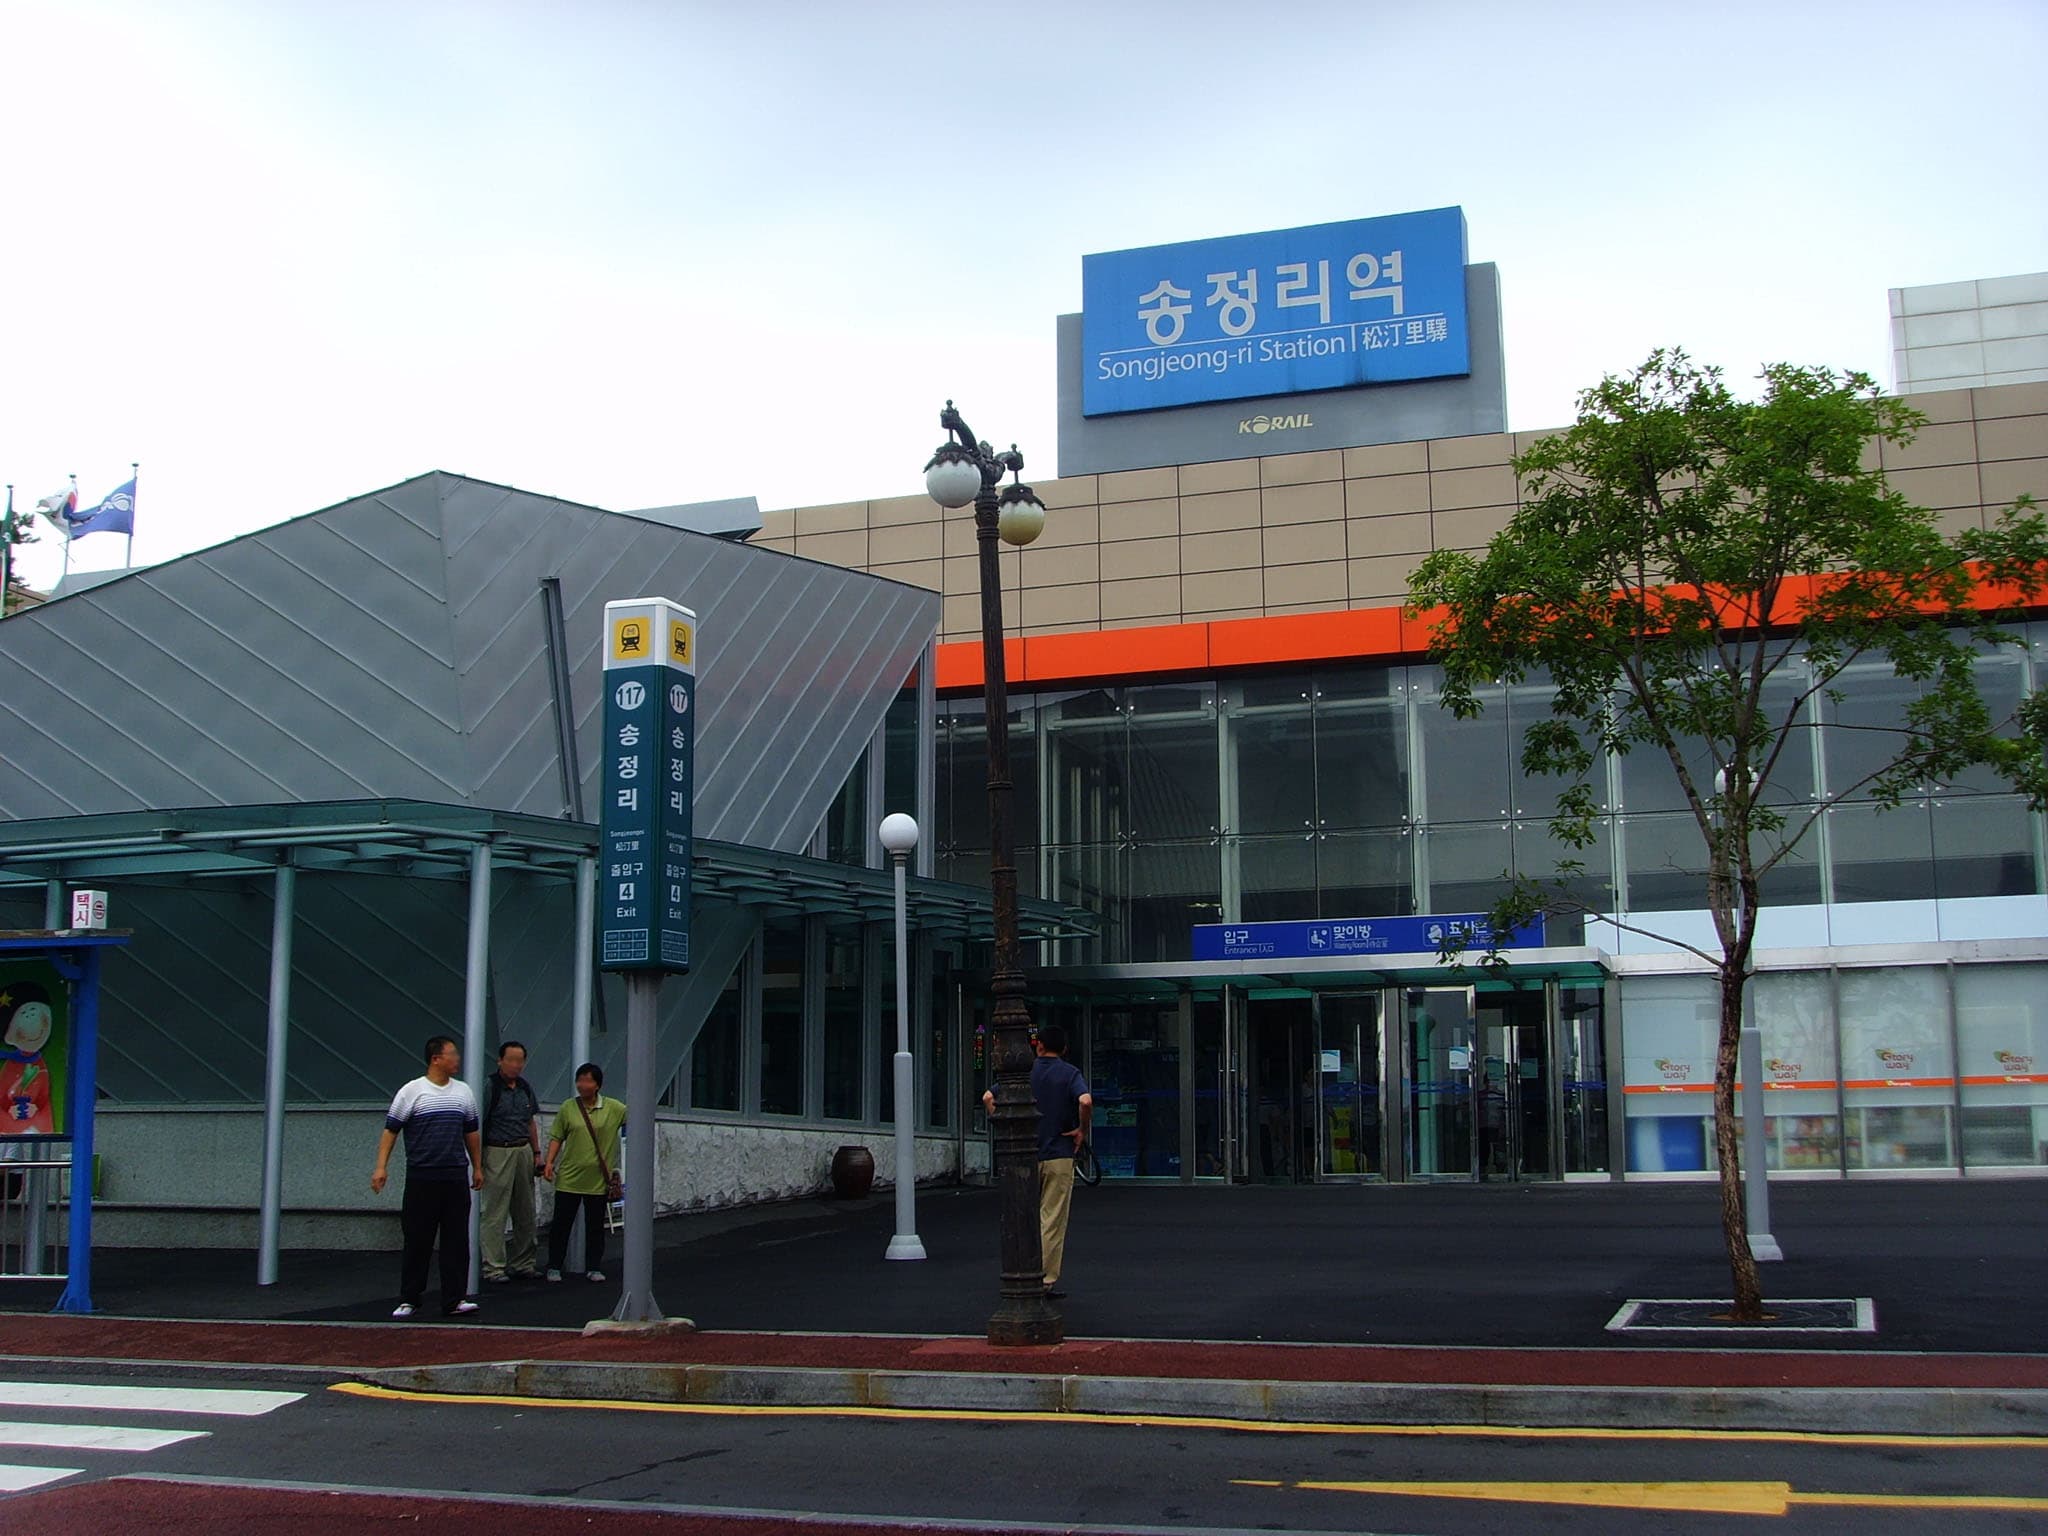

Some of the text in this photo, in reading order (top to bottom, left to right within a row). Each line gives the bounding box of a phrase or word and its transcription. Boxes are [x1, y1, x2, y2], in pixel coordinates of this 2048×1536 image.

[1137, 250, 1404, 346] 송정리역
[1362, 317, 1448, 351] 松汀里驛
[1098, 333, 1345, 381] Songjeong-ri Station
[1238, 413, 1313, 434] KORAIL
[617, 686, 643, 707] 117
[671, 688, 687, 710] 117
[618, 723, 640, 811] 송정리
[670, 726, 685, 815] 송정리
[610, 862, 643, 877] 출입구
[75, 893, 90, 926] 택시
[616, 907, 636, 917] Exit
[669, 908, 682, 920] Exit
[1224, 930, 1249, 944] 입구
[1333, 925, 1372, 939] 맞이방
[1224, 945, 1258, 954] Entrance
